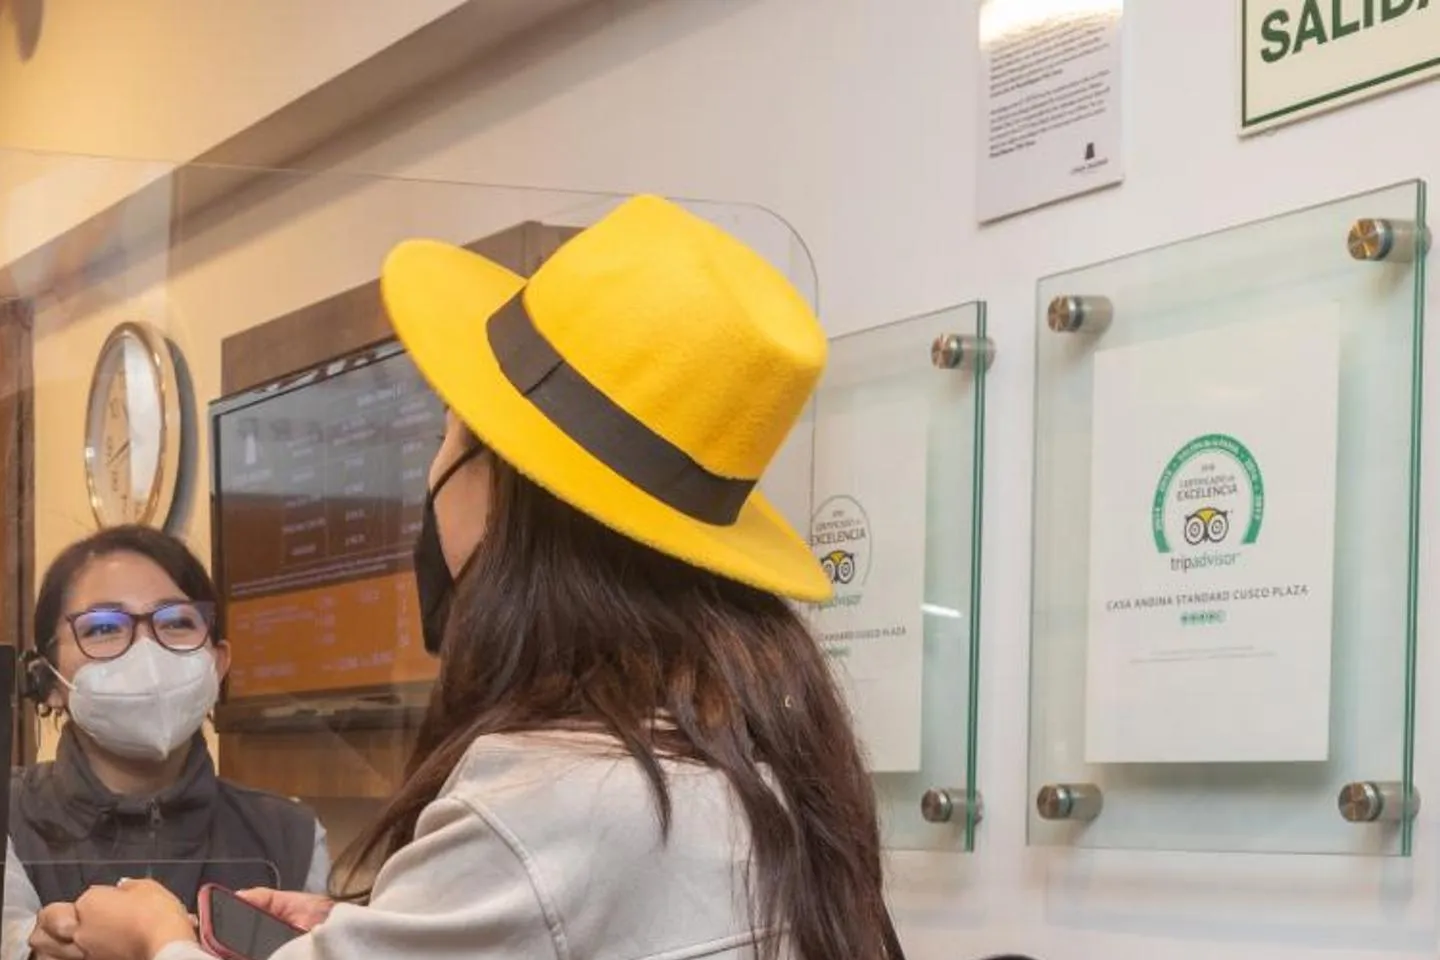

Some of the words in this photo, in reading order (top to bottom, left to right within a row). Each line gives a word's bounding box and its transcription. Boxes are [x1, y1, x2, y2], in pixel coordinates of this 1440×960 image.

[1260, 0, 1430, 63] SALI
[1176, 484, 1237, 502] EXCELENCIA
[1170, 551, 1236, 572] tripadvisor
[1176, 590, 1229, 605] STANDARD
[1273, 585, 1308, 596] PLAZA
